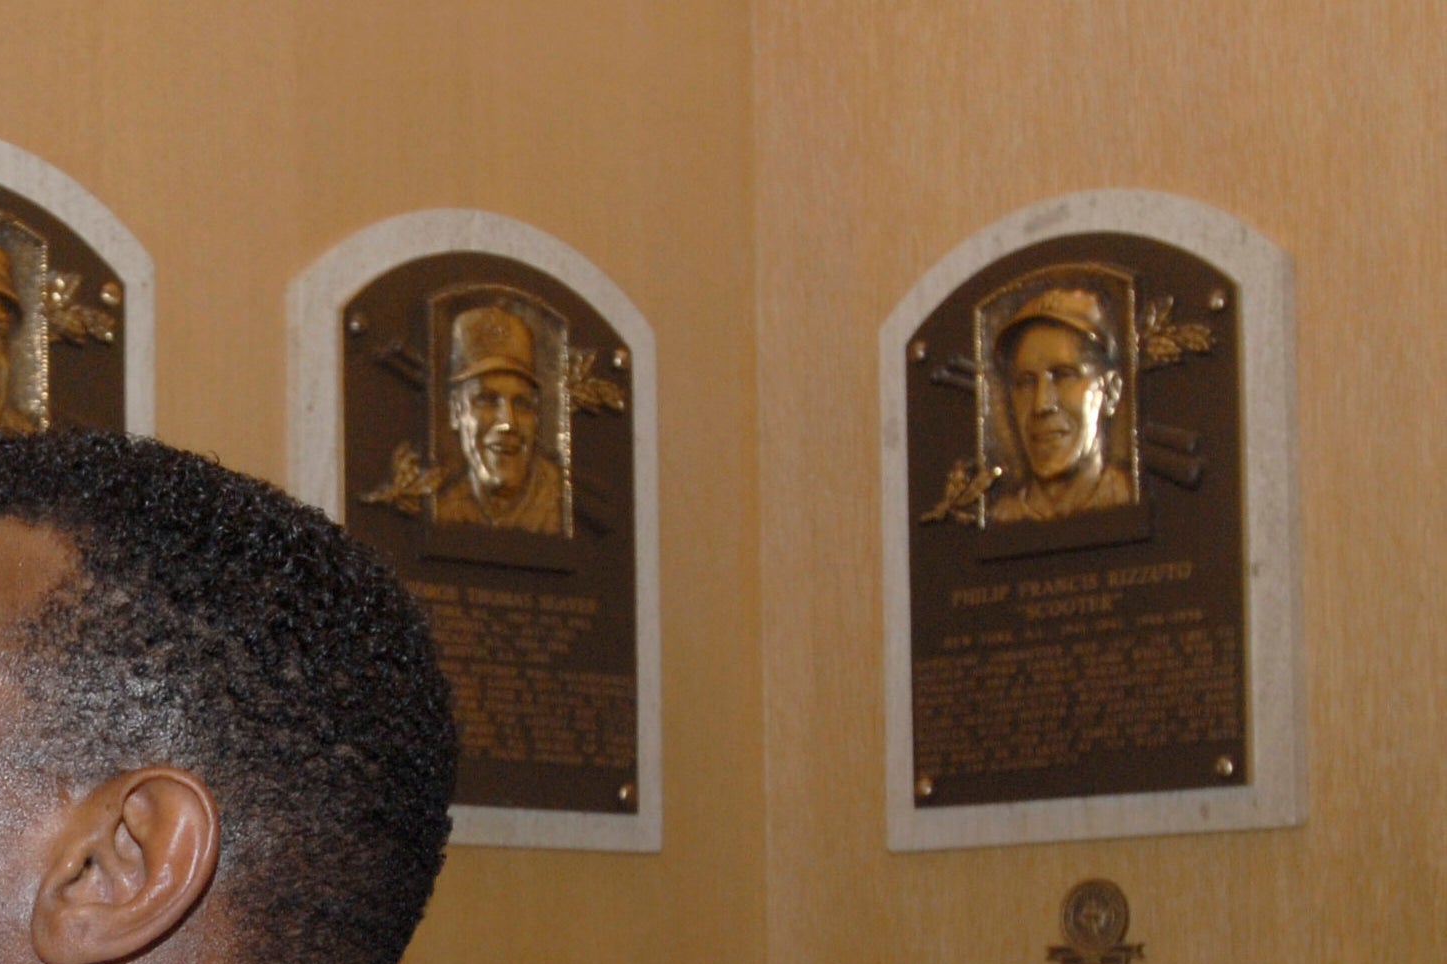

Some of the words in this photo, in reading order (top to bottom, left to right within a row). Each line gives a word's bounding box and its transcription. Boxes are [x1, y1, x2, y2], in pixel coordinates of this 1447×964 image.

[952, 584, 1010, 608] PHILIP
[1018, 573, 1099, 597] FRANCIS
[1107, 560, 1193, 587] RIZZUTO
